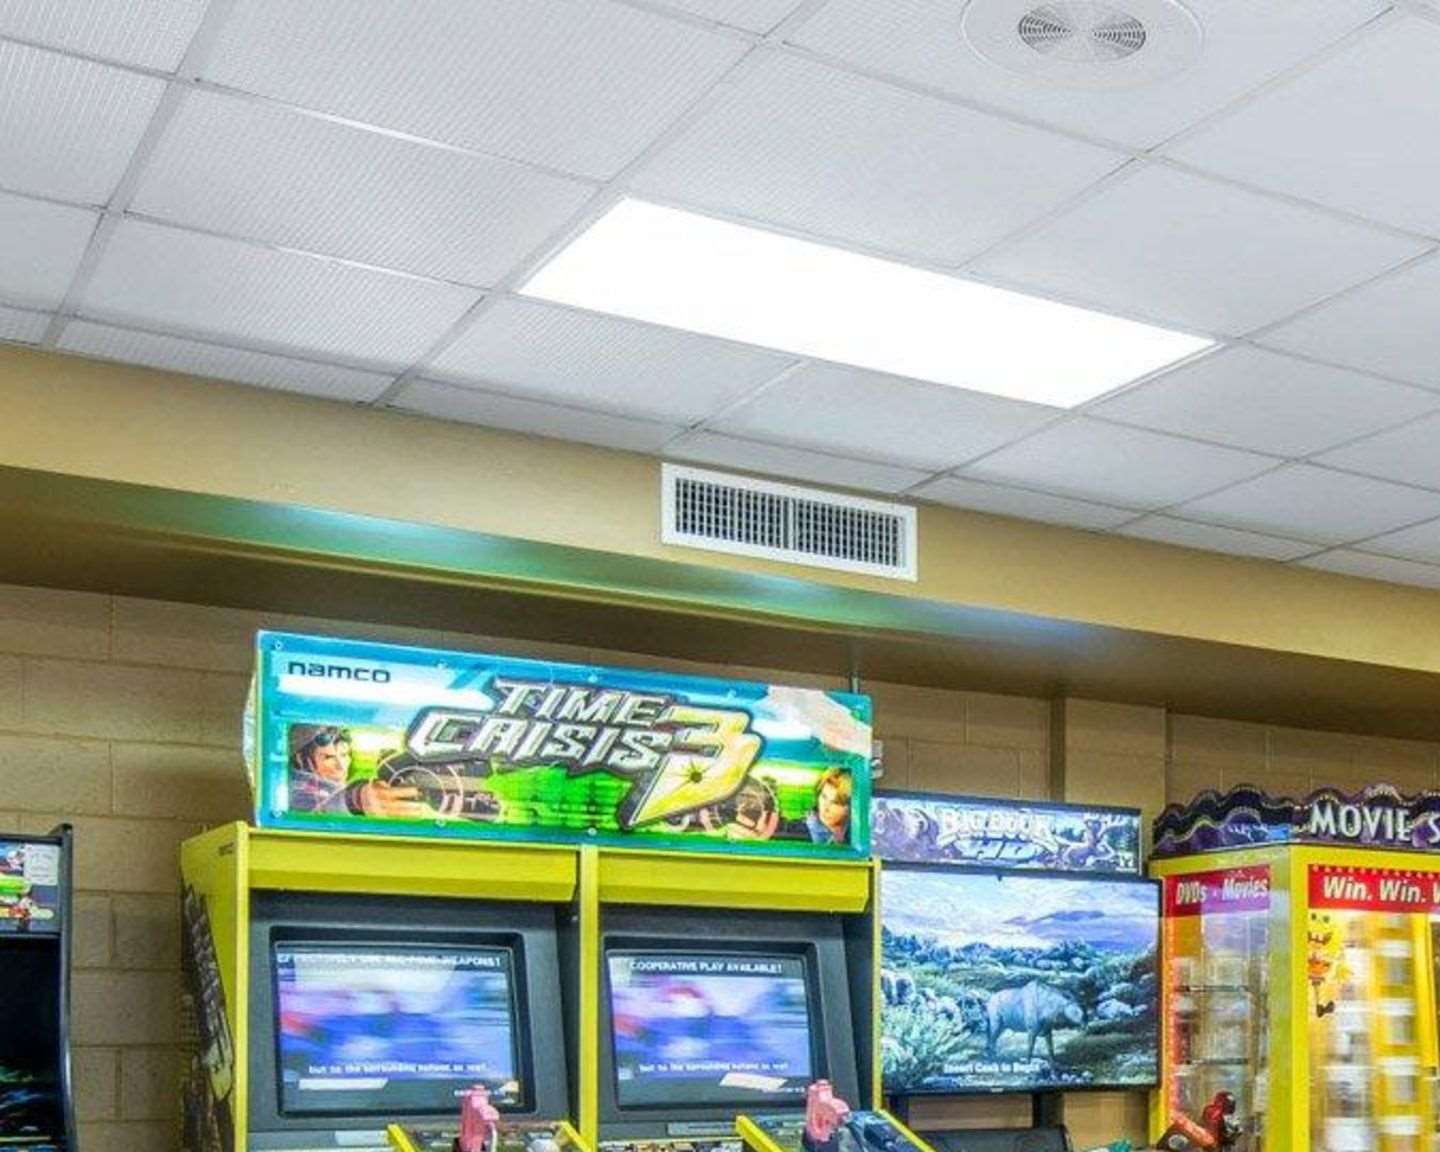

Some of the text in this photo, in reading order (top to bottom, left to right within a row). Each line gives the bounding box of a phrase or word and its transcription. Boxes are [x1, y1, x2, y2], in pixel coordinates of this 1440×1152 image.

[288, 661, 390, 683] namco
[495, 679, 667, 726] TIME
[407, 704, 762, 828] CRISIS 3
[1310, 802, 1413, 841] MOVIE
[1175, 876, 1268, 905] DVDs Movies
[1323, 876, 1373, 900] Win.
[1380, 879, 1426, 903] Win.
[630, 961, 697, 972] COOPERATIVE
[700, 962, 724, 972] PLAY
